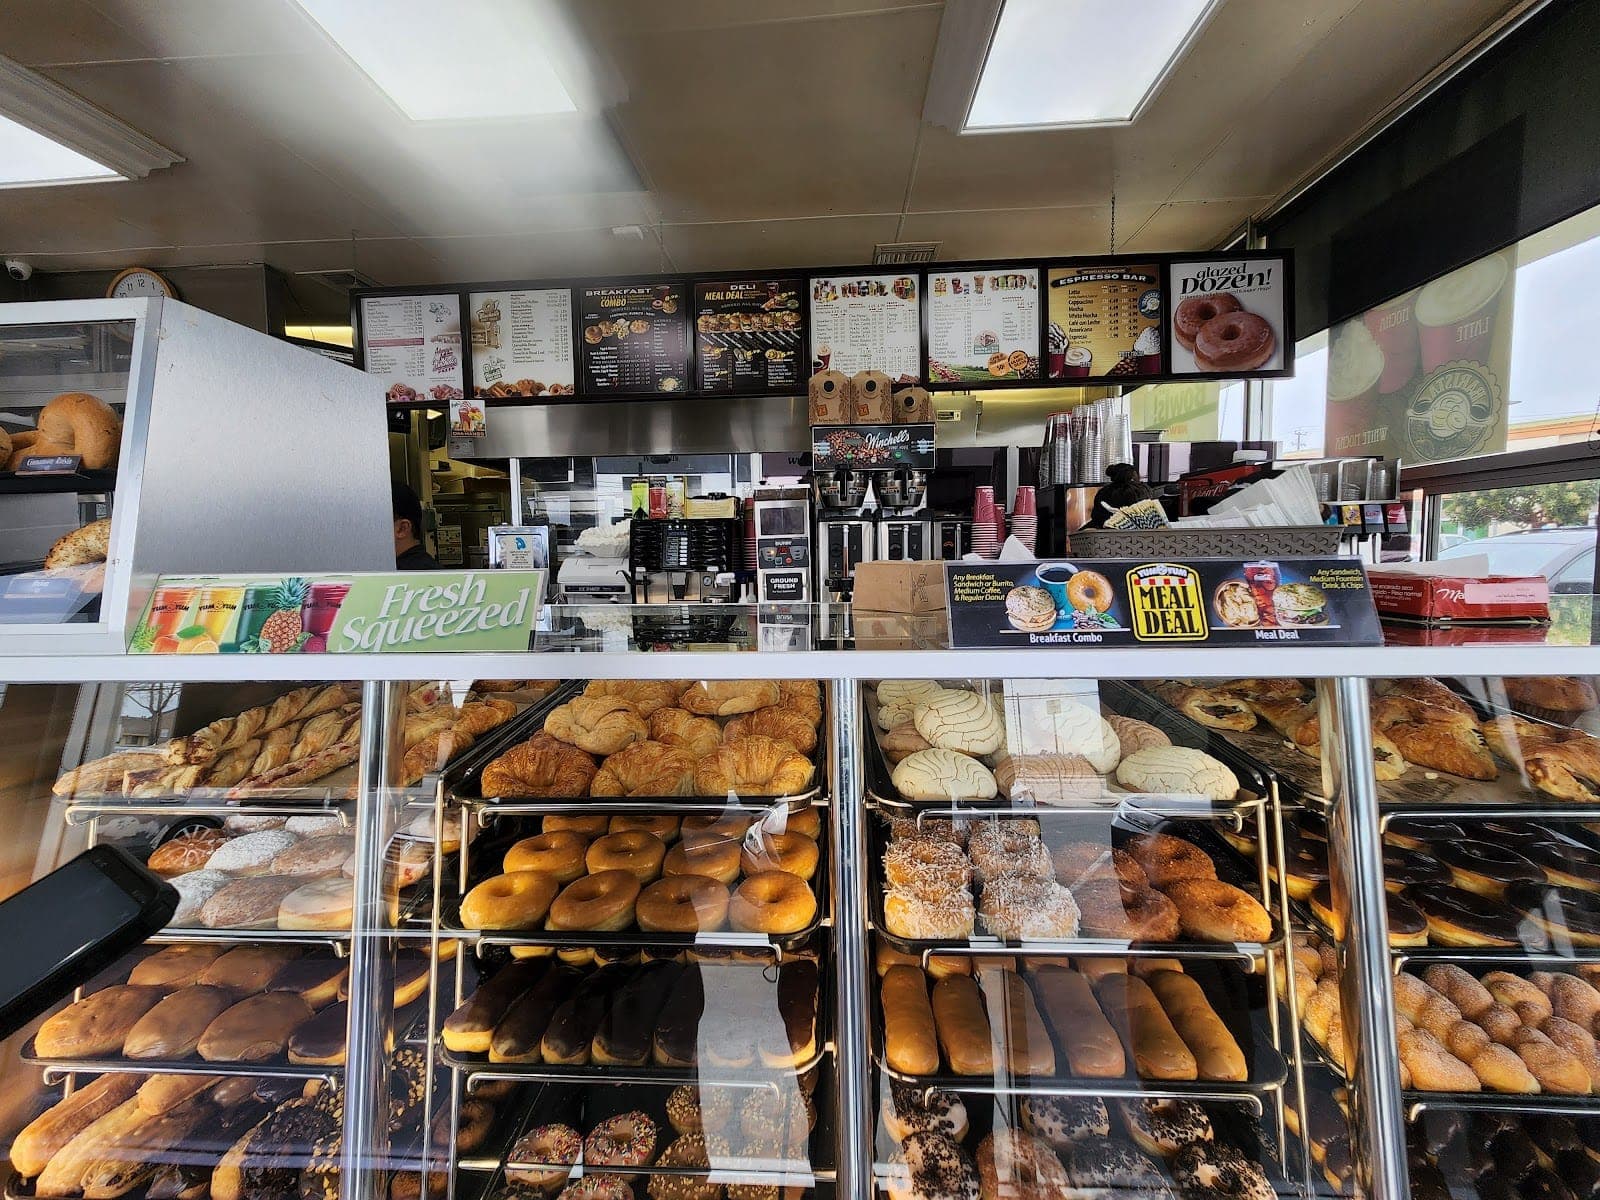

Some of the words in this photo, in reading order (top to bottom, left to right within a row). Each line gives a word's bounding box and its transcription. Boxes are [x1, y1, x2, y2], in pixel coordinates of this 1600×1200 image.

[1197, 263, 1247, 281] glazed
[137, 279, 145, 287] 12
[1059, 273, 1119, 285] ESPRESSO
[1122, 273, 1147, 281] BAR
[127, 283, 133, 291] 11
[585, 288, 651, 296] BREAKFAST
[705, 292, 724, 300] MEAL
[726, 291, 743, 299] DEAL
[600, 298, 626, 307] COMBO
[865, 429, 911, 451] Winchell's
[1137, 567, 1158, 577] YUM
[1167, 567, 1187, 577] YUM
[1317, 568, 1330, 576] Any
[965, 573, 995, 581] Breakfast
[953, 580, 983, 588] Sandwich
[992, 580, 1014, 588] Burrito,
[1346, 582, 1364, 590] Chips
[377, 575, 489, 622] Fresh
[960, 594, 984, 602] Regular
[1139, 586, 1195, 609] MEAL
[338, 588, 532, 652] Squeezed
[1144, 610, 1200, 634] DEAL
[1029, 633, 1072, 644] Breakfast
[1072, 633, 1103, 643] Combo
[1255, 630, 1275, 640] Meal
[1275, 630, 1299, 639] Deal
